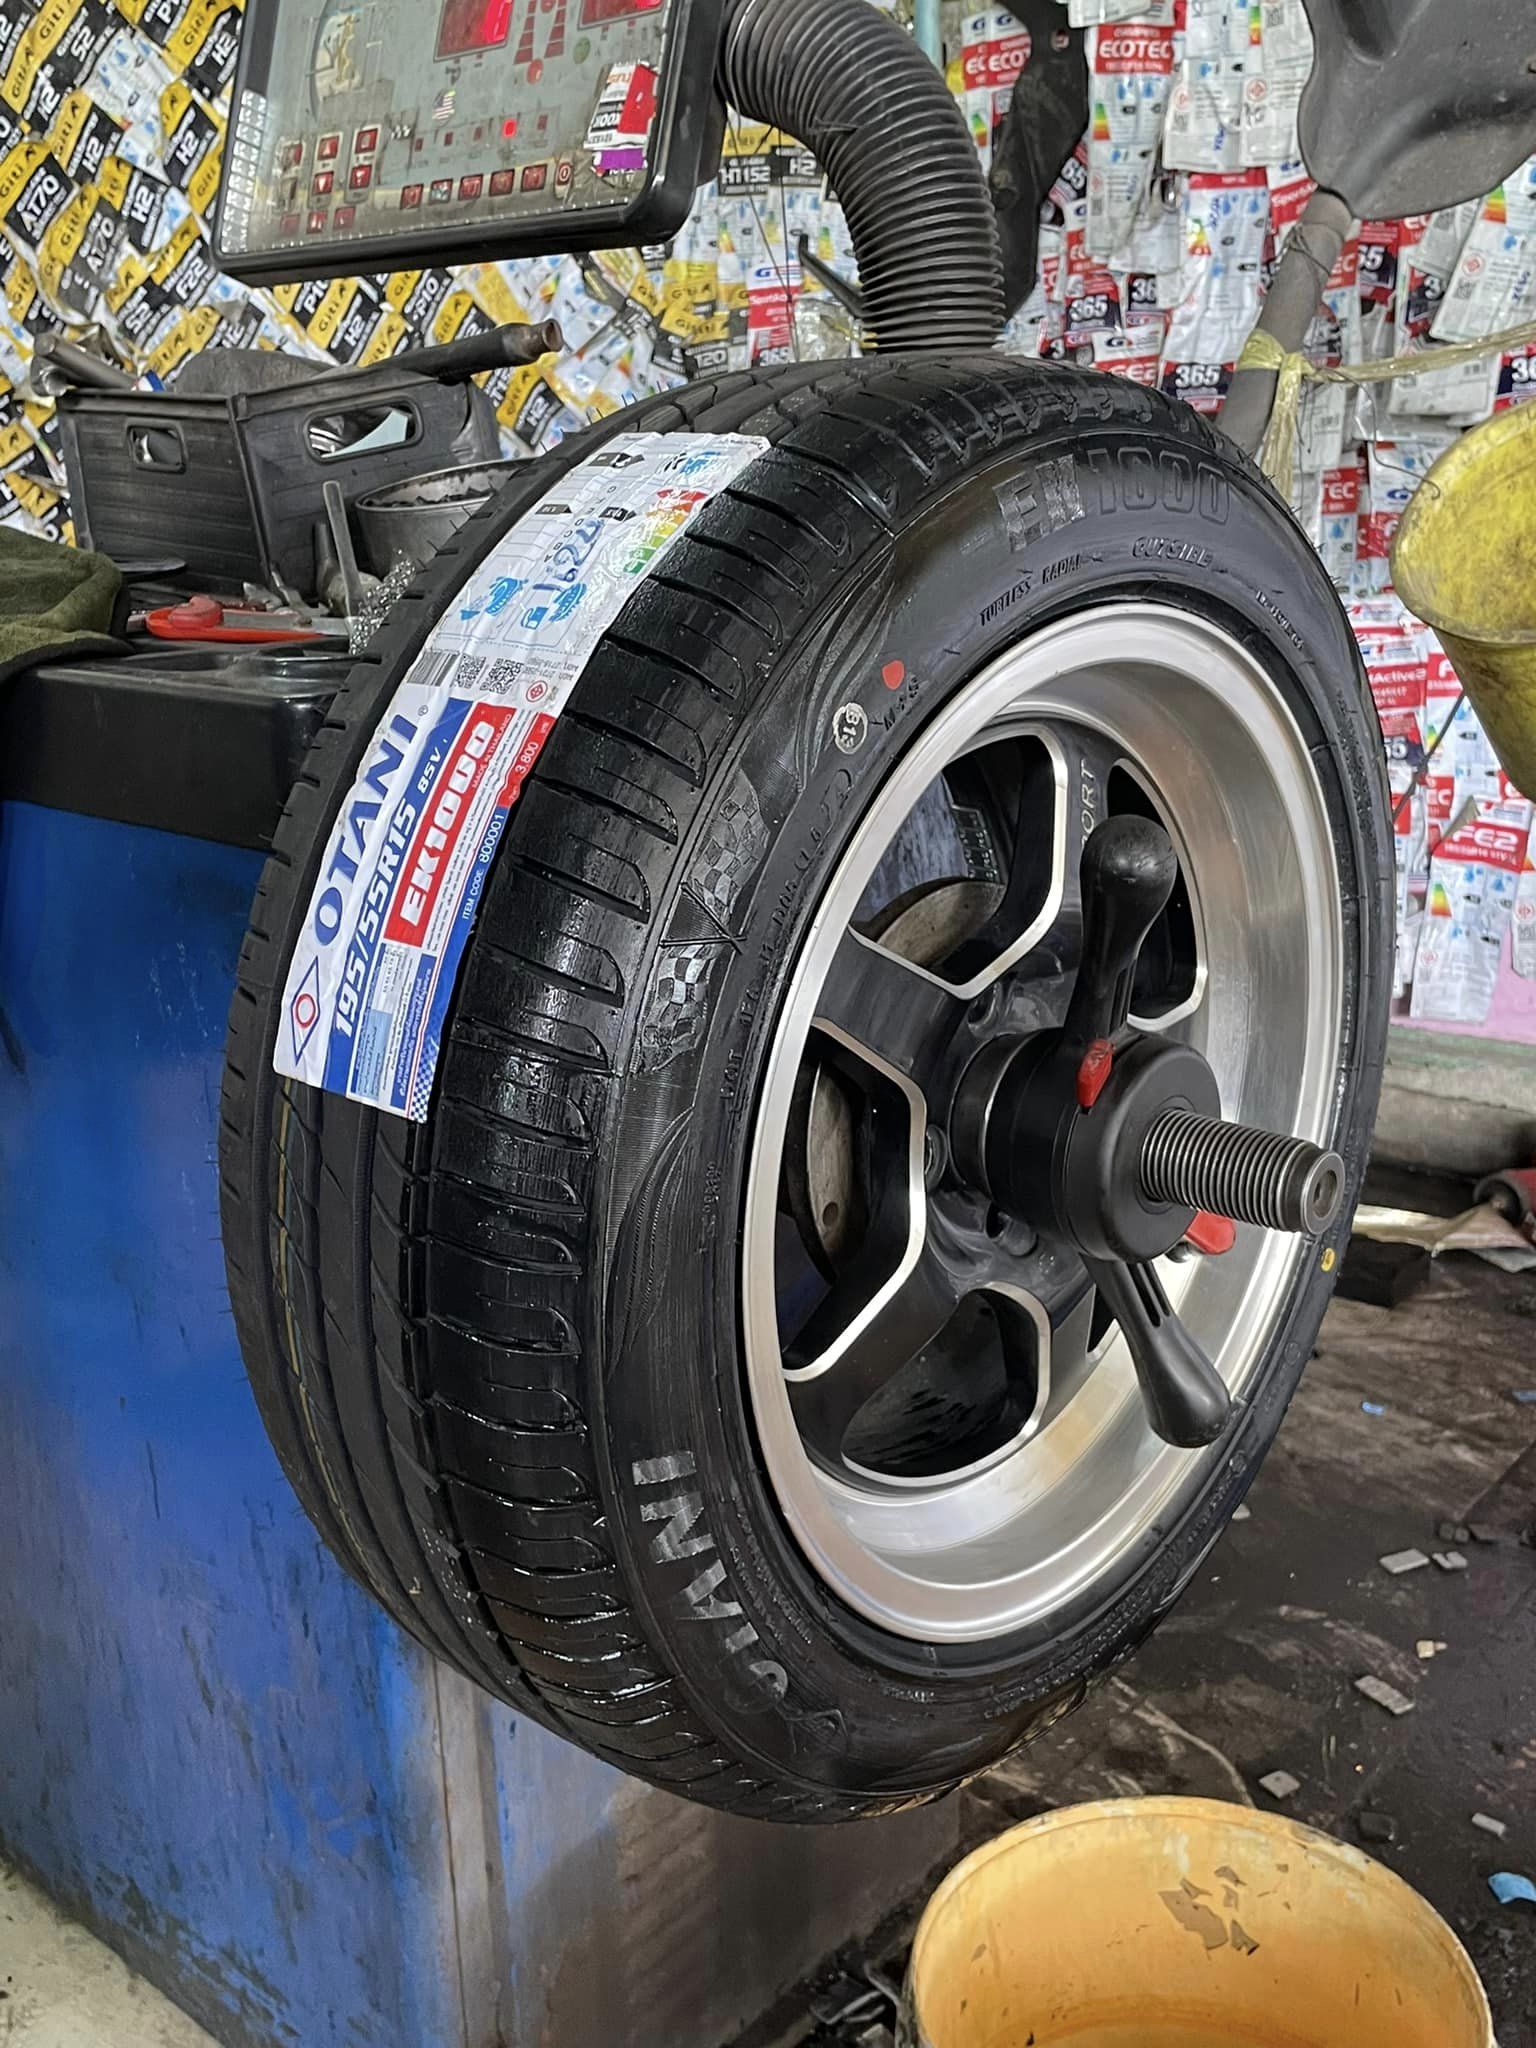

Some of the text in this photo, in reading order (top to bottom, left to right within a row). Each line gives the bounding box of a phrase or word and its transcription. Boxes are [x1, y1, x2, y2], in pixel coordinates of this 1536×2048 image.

[70, 24, 96, 62] S2
[1098, 40, 1172, 58] ECOTEC
[81, 135, 107, 173] H2
[173, 129, 202, 165] H2
[789, 158, 817, 176] H2
[16, 173, 62, 231] AT70
[130, 183, 156, 223] H2
[175, 254, 207, 299] F22
[124, 299, 153, 334] S2
[1069, 295, 1108, 322] 365
[344, 314, 364, 346] H2
[1175, 364, 1220, 388] 365
[313, 712, 419, 943] OTANI
[400, 719, 495, 925] EK1000
[462, 898, 475, 919] ITEM
[479, 812, 505, 863] 800001
[333, 798, 418, 1037] 195/55R15
[417, 745, 440, 793] 85V
